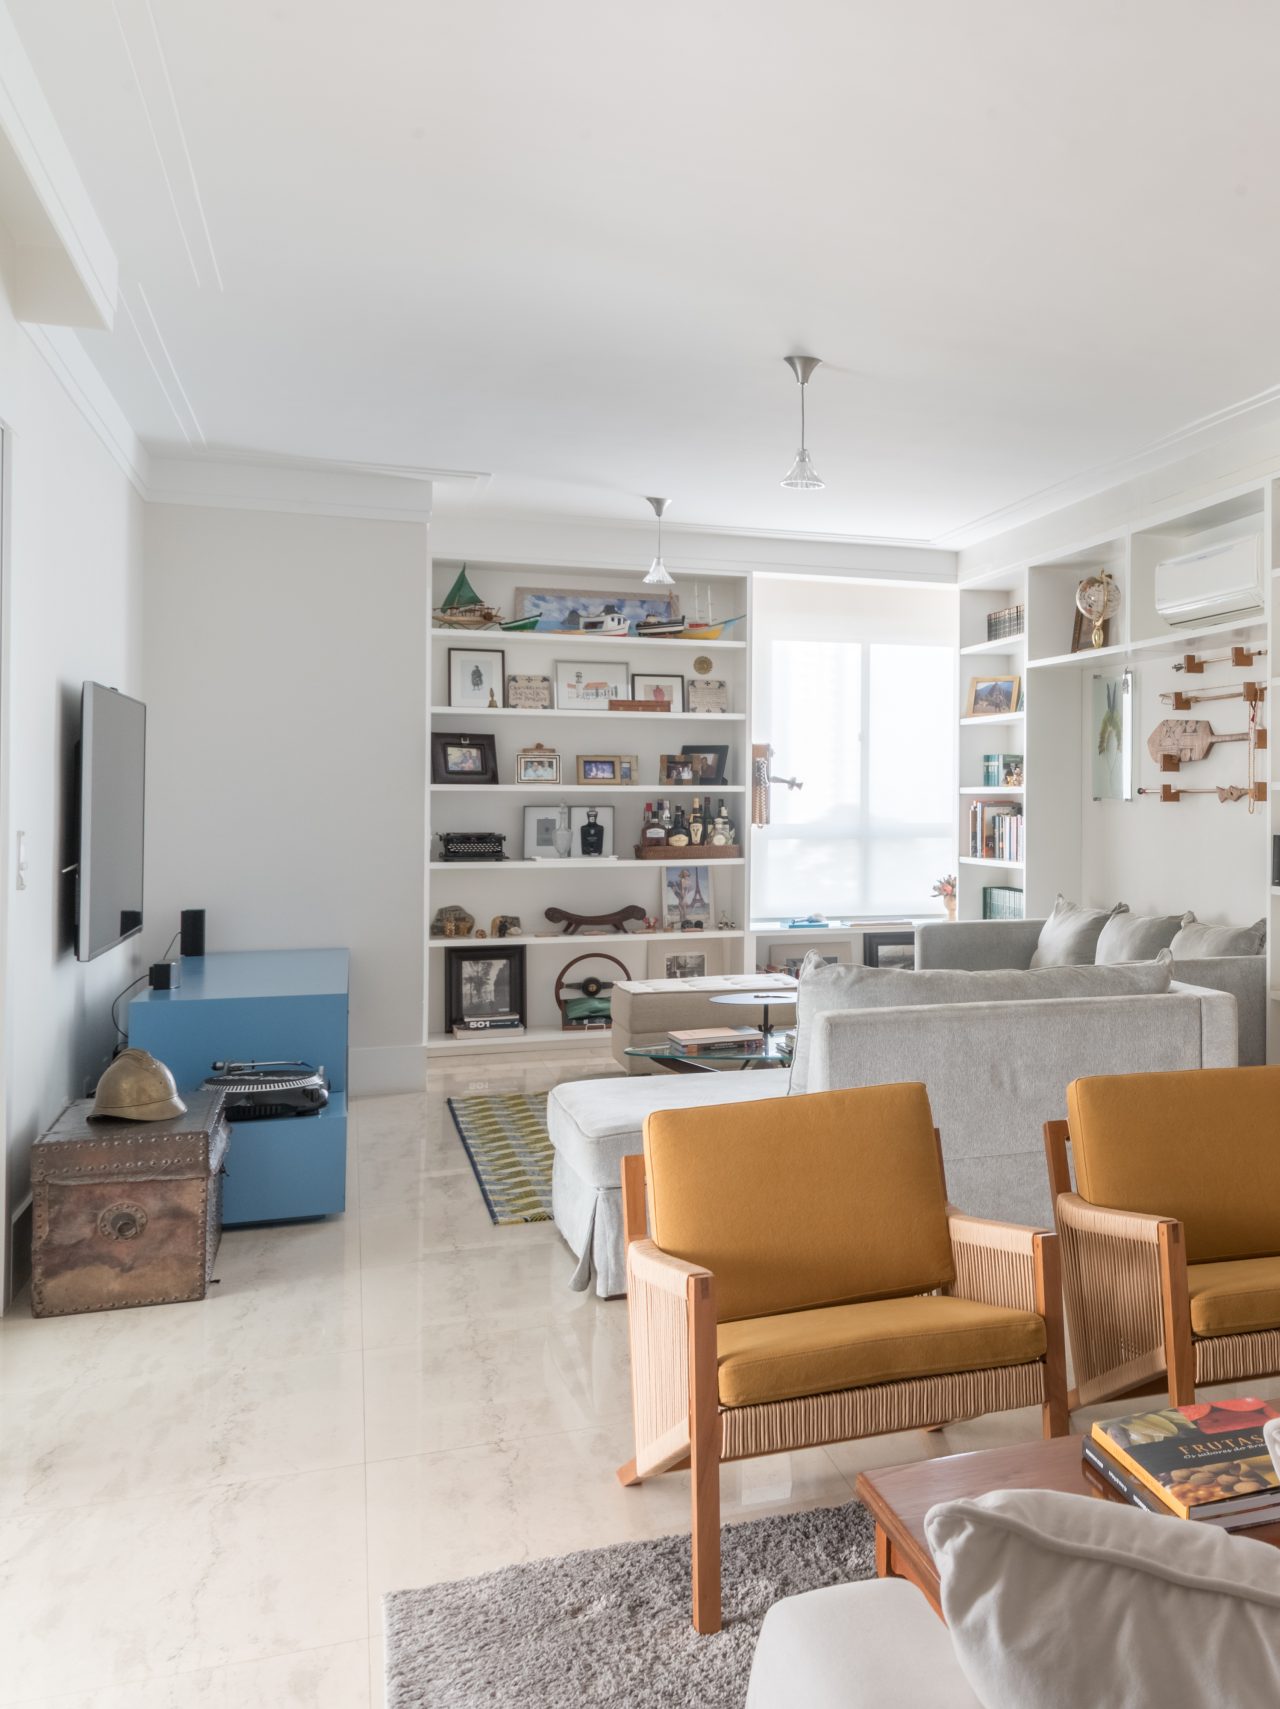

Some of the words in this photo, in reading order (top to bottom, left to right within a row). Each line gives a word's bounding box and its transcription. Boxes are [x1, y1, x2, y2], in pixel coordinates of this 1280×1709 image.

[1178, 1434, 1264, 1455] FRUTAS
[1197, 1448, 1233, 1458] sabores
[1246, 1442, 1268, 1450] Bra
